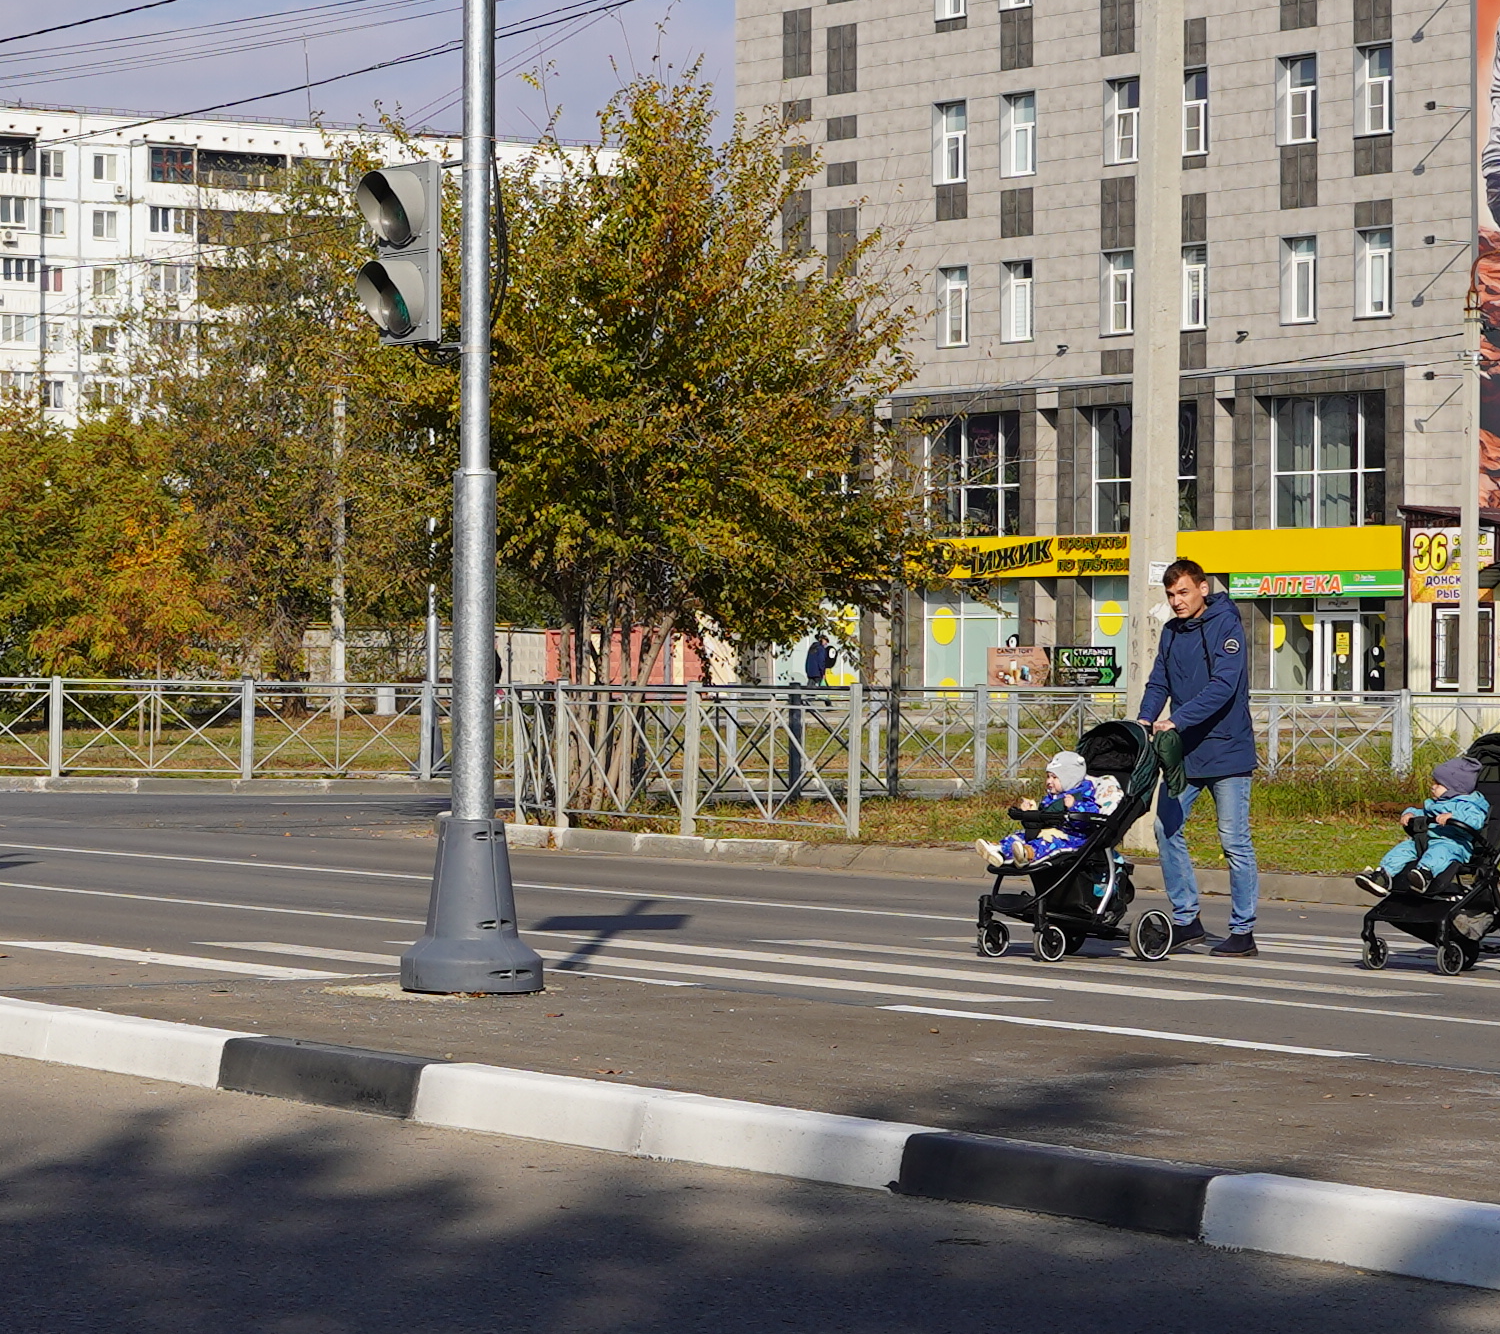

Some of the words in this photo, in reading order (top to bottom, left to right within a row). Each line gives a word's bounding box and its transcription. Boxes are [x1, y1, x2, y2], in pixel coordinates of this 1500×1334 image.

[1413, 533, 1448, 571] 36
[1257, 574, 1343, 596] АПТЕКА
[1073, 648, 1113, 656] СТИЛЬНЫЕ
[1073, 656, 1113, 666] КУХНИ
